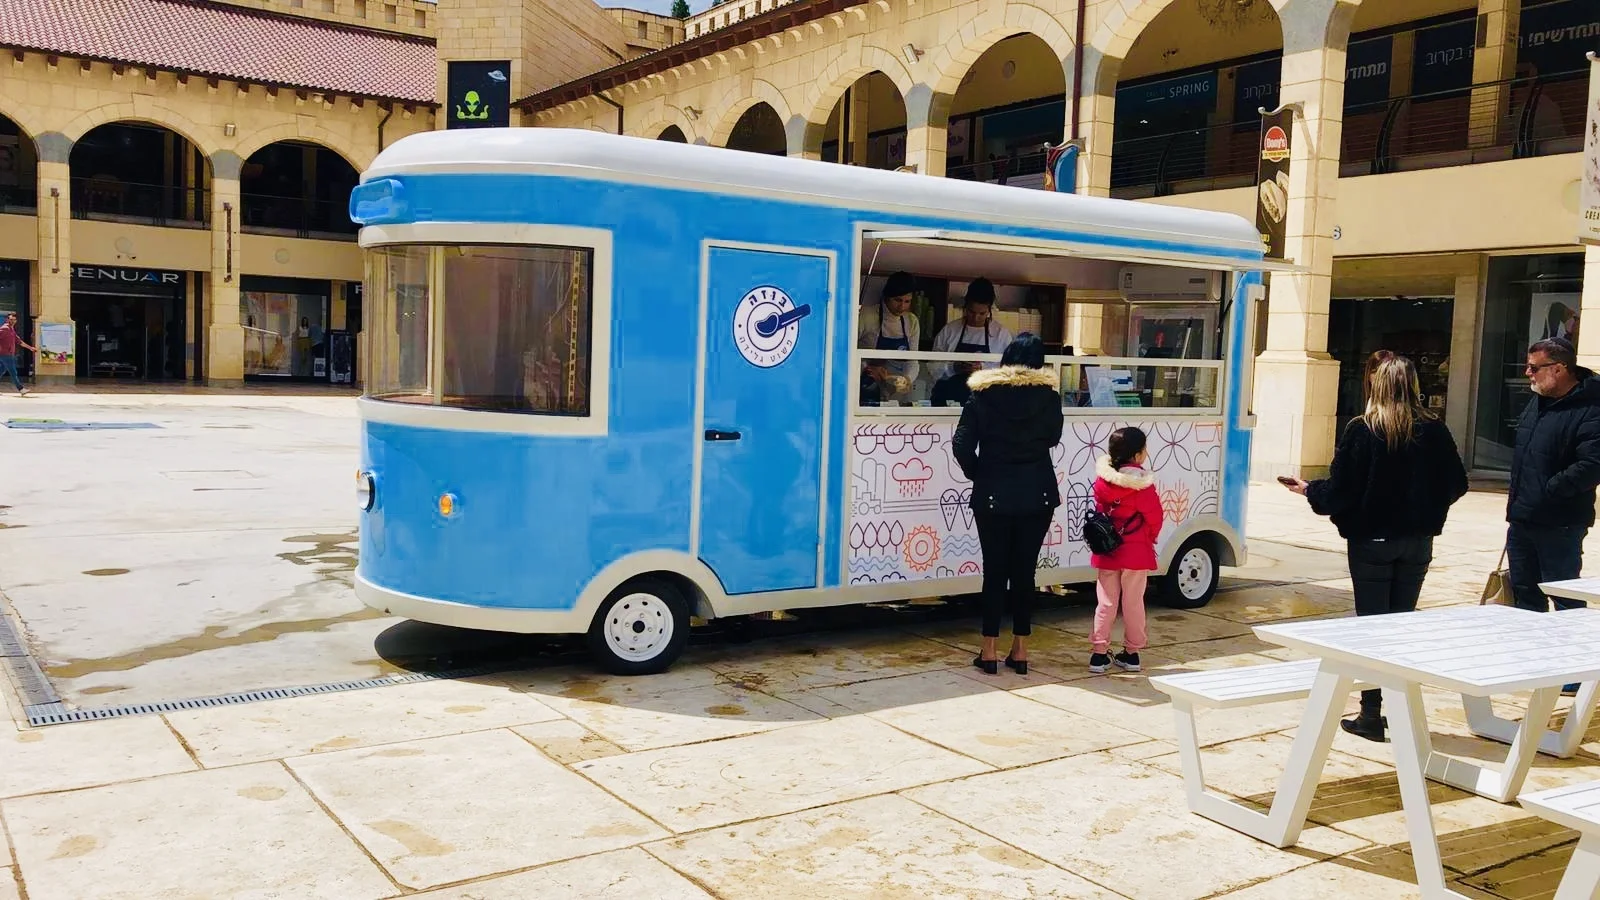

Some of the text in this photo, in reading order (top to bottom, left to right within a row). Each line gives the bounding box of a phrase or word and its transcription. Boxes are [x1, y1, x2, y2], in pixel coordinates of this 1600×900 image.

[1425, 47, 1463, 66] בקרוב
[1169, 80, 1210, 98] SPRING
[748, 290, 787, 307] בוזה
